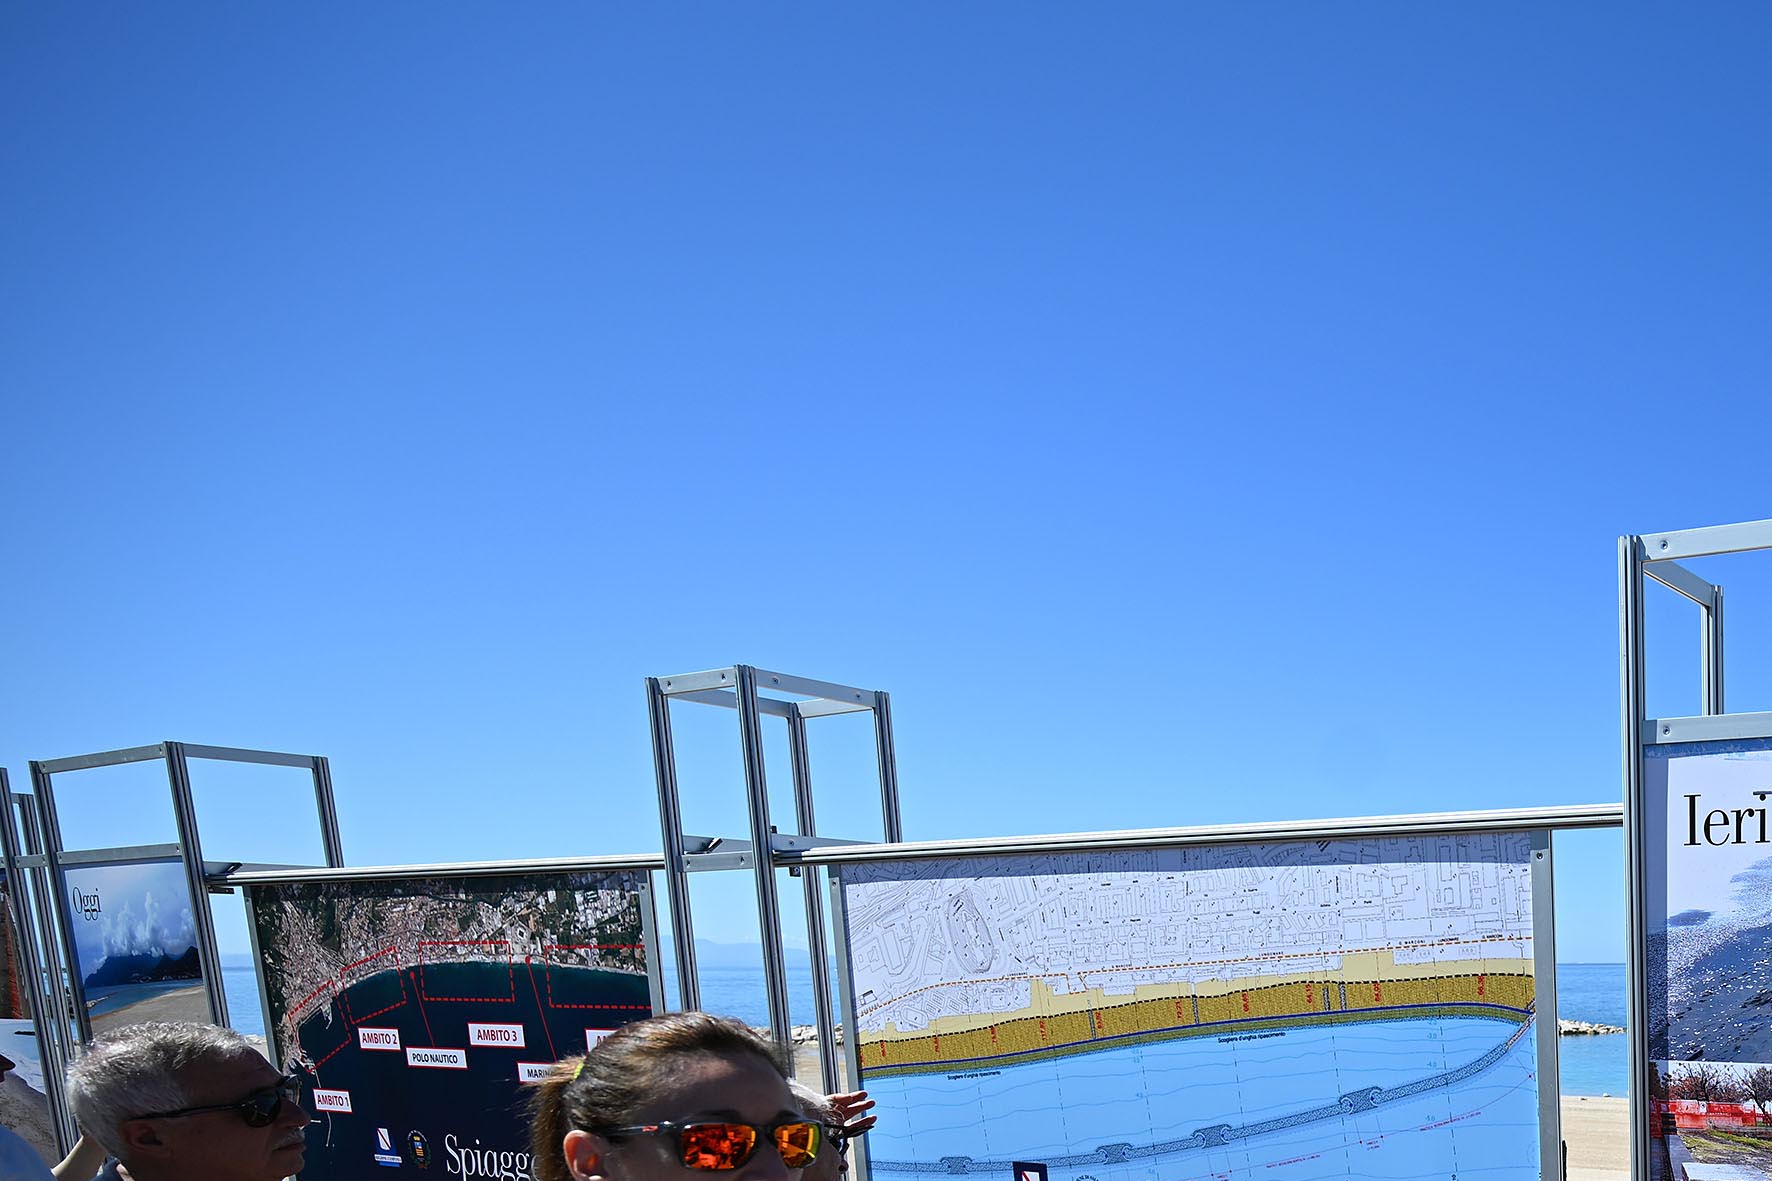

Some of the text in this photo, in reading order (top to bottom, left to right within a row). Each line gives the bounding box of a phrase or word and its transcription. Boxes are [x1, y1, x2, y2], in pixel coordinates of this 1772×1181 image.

[1683, 793, 1771, 847] Ieri
[72, 886, 102, 921] Oggi
[362, 1032, 398, 1045] AMBITO 2
[477, 1029, 518, 1042] AMBITO 3
[412, 1053, 458, 1064] POLO NAUTICO
[527, 1068, 554, 1079] MARIN
[317, 1094, 350, 1107] AMBITO 1
